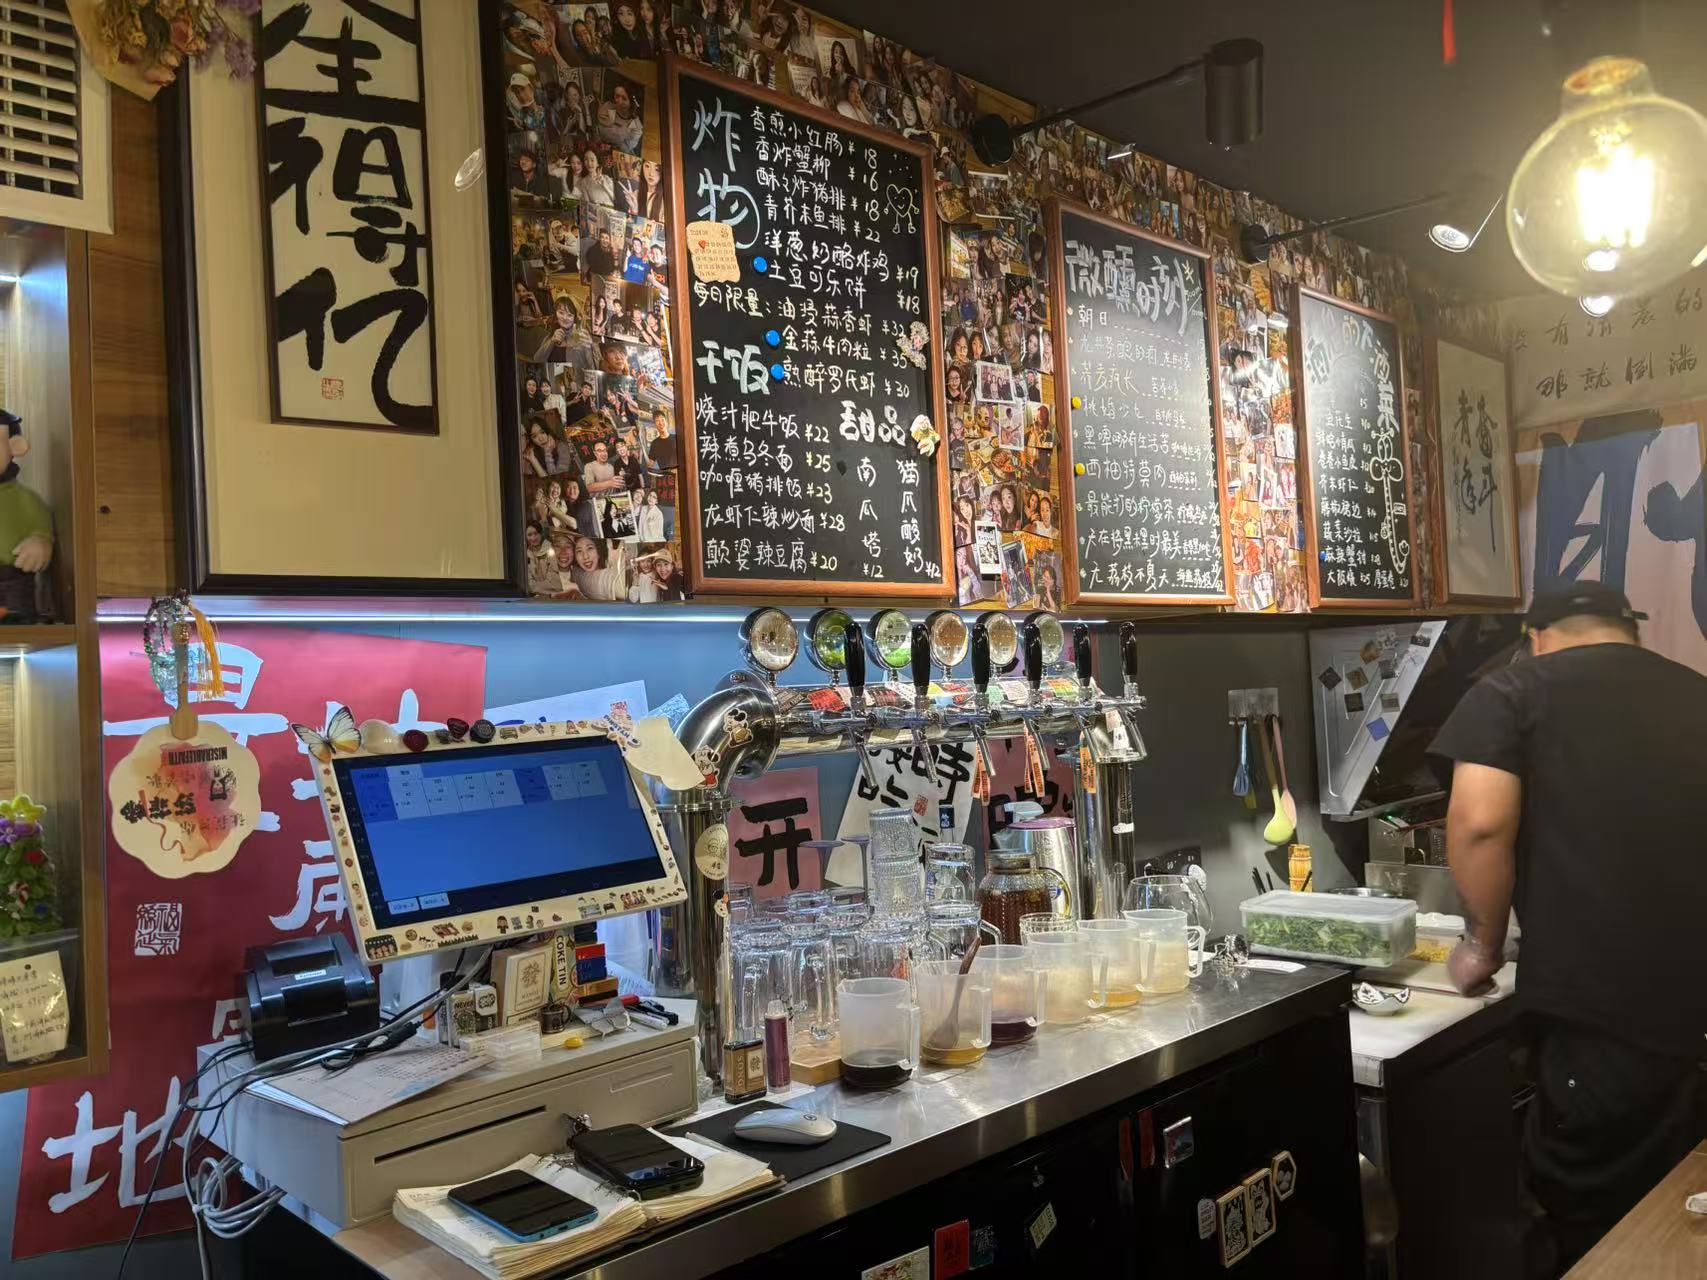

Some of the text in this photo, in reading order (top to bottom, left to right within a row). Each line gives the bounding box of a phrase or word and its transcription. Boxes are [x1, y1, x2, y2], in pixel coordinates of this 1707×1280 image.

[750, 105, 843, 157] 香煎小红肠
[755, 137, 830, 180] 香炸蟹柳
[764, 194, 847, 235] 青芥末鱼排
[764, 229, 890, 282] 洋葱奶酪炸鸡
[769, 262, 867, 309] 土豆可乐饼
[1078, 304, 1108, 331] 朝日
[782, 325, 872, 362] 金蒜牛肉粒
[696, 340, 771, 395] 干饭
[1536, 343, 1697, 399] 那就倒满
[696, 392, 831, 444] 烧汁肥牛饭 ¥22
[839, 399, 906, 447] 甜品
[699, 431, 832, 473] 辣煮乌冬面 ¥25
[700, 463, 833, 505] 咖喱猪排饭 ¥23
[856, 456, 882, 559] 南瓜塔
[704, 502, 846, 534] 龙虾仁辣炒面 ¥28
[809, 551, 838, 571] ¥20
[735, 797, 812, 890] 开
[556, 935, 568, 986] COKE TIN
